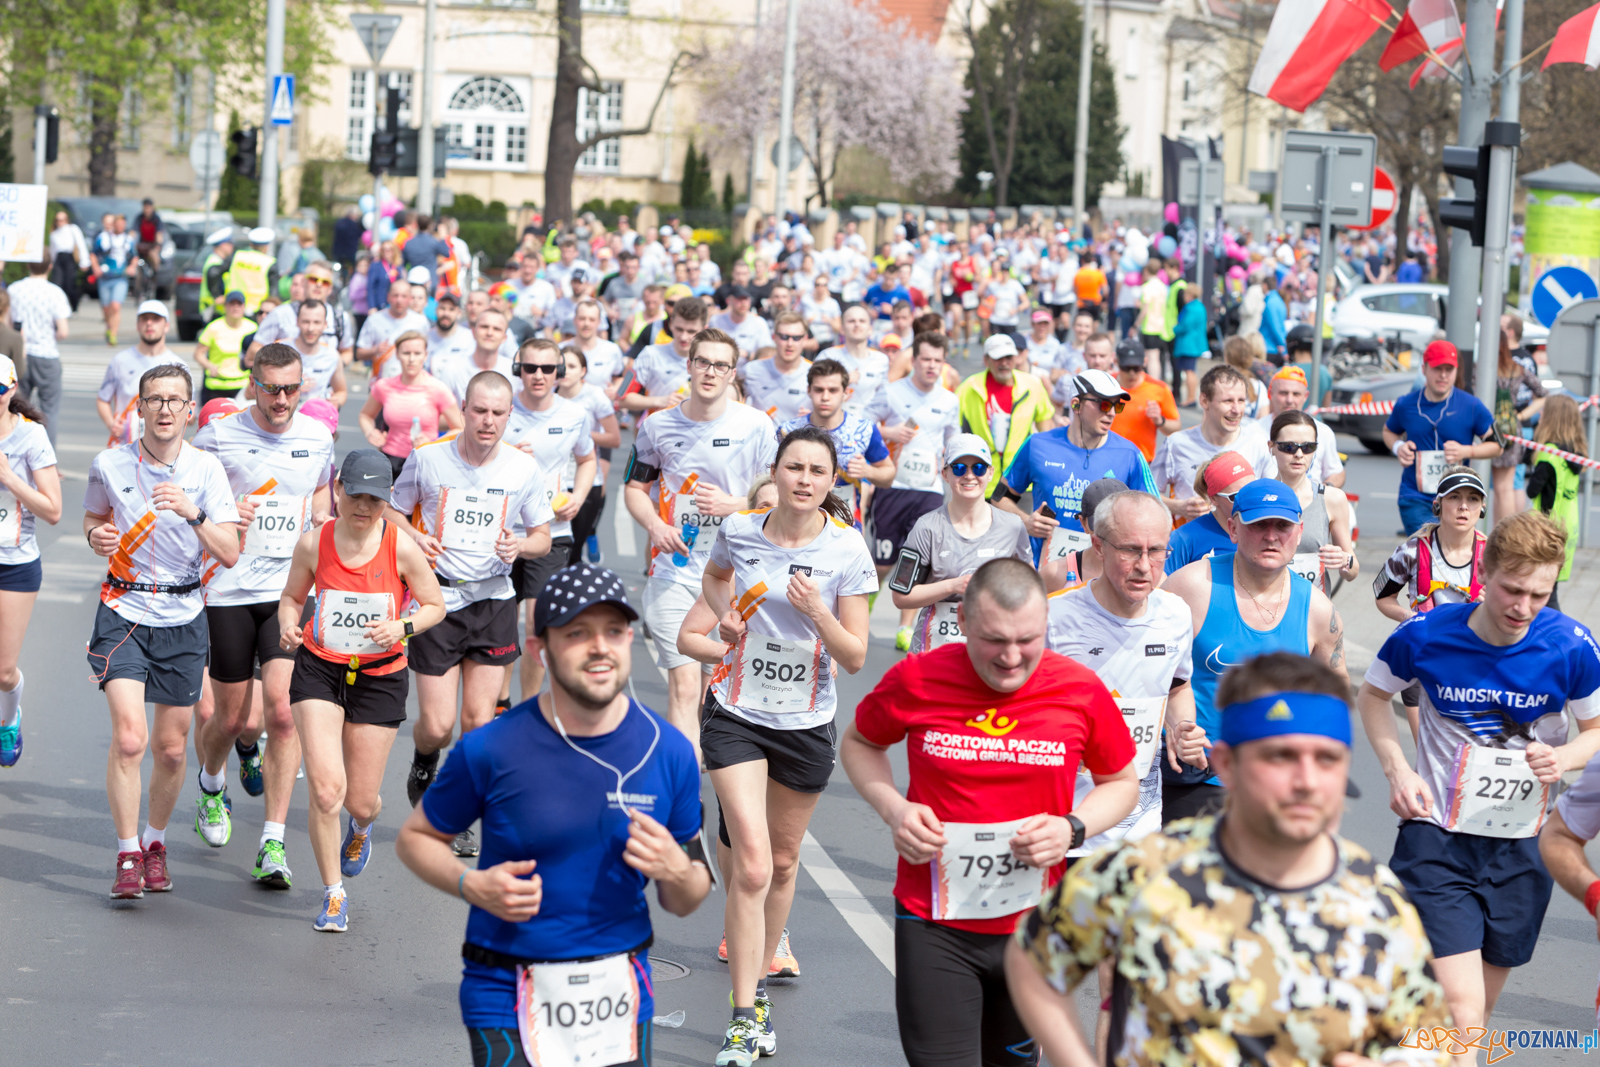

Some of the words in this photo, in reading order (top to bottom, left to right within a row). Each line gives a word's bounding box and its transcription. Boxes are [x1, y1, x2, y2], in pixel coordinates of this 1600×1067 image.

[903, 462, 931, 474] 4378
[256, 515, 296, 531] 1076
[454, 509, 494, 527] 8519
[876, 539, 893, 560] 19
[1089, 648, 1104, 656] 4F
[752, 658, 806, 682] 9502
[761, 682, 793, 692] Katarzyna
[1436, 684, 1502, 704] YANOSIK
[1505, 691, 1549, 708] TEAM
[924, 730, 1005, 751] SPORTOWA
[1008, 739, 1066, 754] PACZKA
[1128, 725, 1154, 744] 85
[923, 743, 978, 761] POCZTOWA
[979, 750, 1016, 763] GRUPA
[1017, 753, 1065, 766] BIEGOWA
[1475, 776, 1534, 801] 2279
[959, 853, 1029, 878] 7934
[541, 992, 629, 1028] 10306
